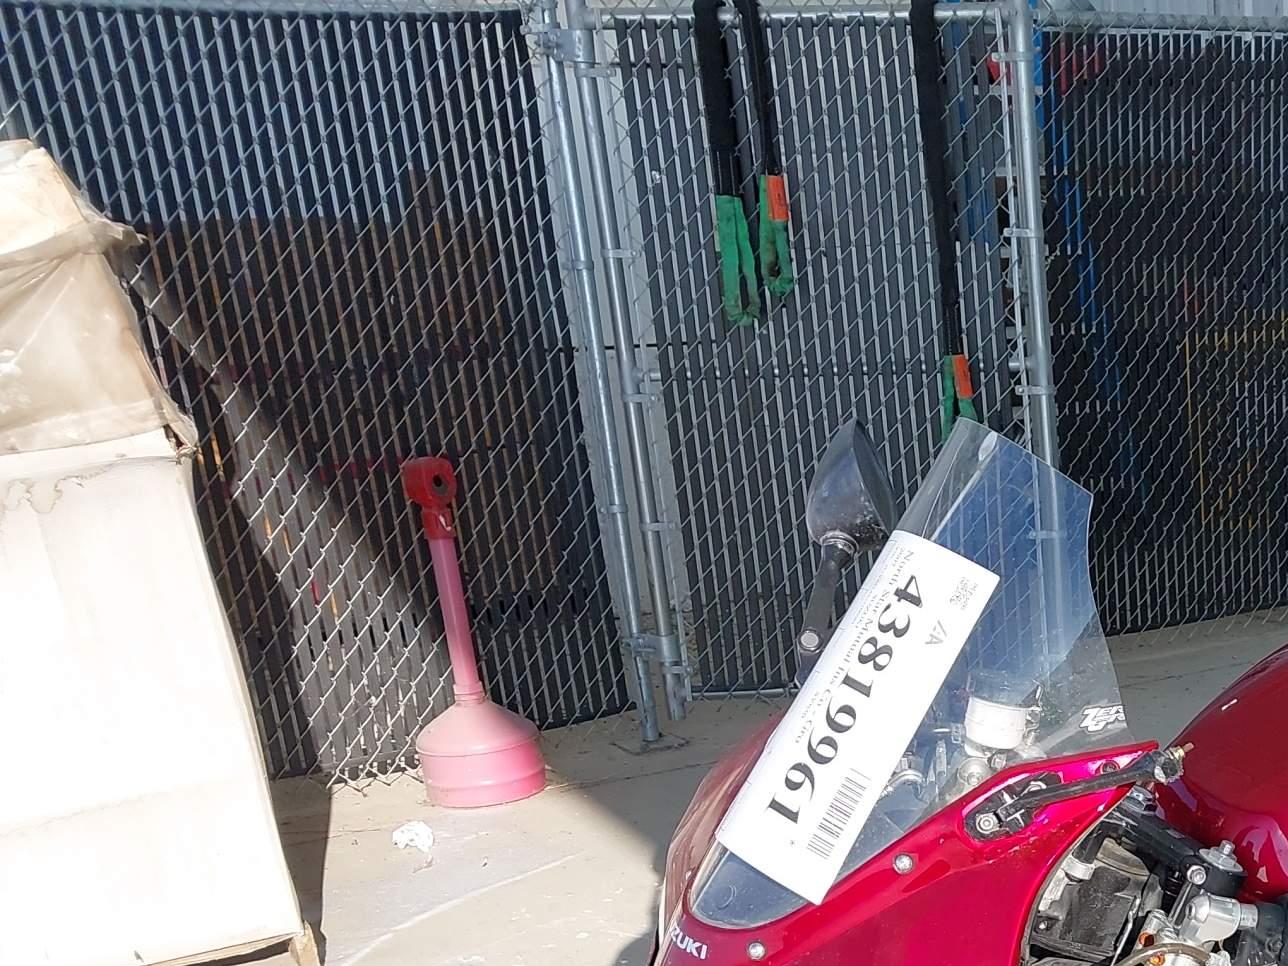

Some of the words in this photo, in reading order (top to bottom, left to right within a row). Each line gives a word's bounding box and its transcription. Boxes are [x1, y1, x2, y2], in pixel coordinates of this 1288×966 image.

[887, 548, 915, 588] North
[870, 588, 891, 616] Star
[842, 616, 874, 664] Mutual
[828, 665, 845, 687] Ins
[768, 574, 924, 825] 43819961
[815, 687, 832, 709] Co
